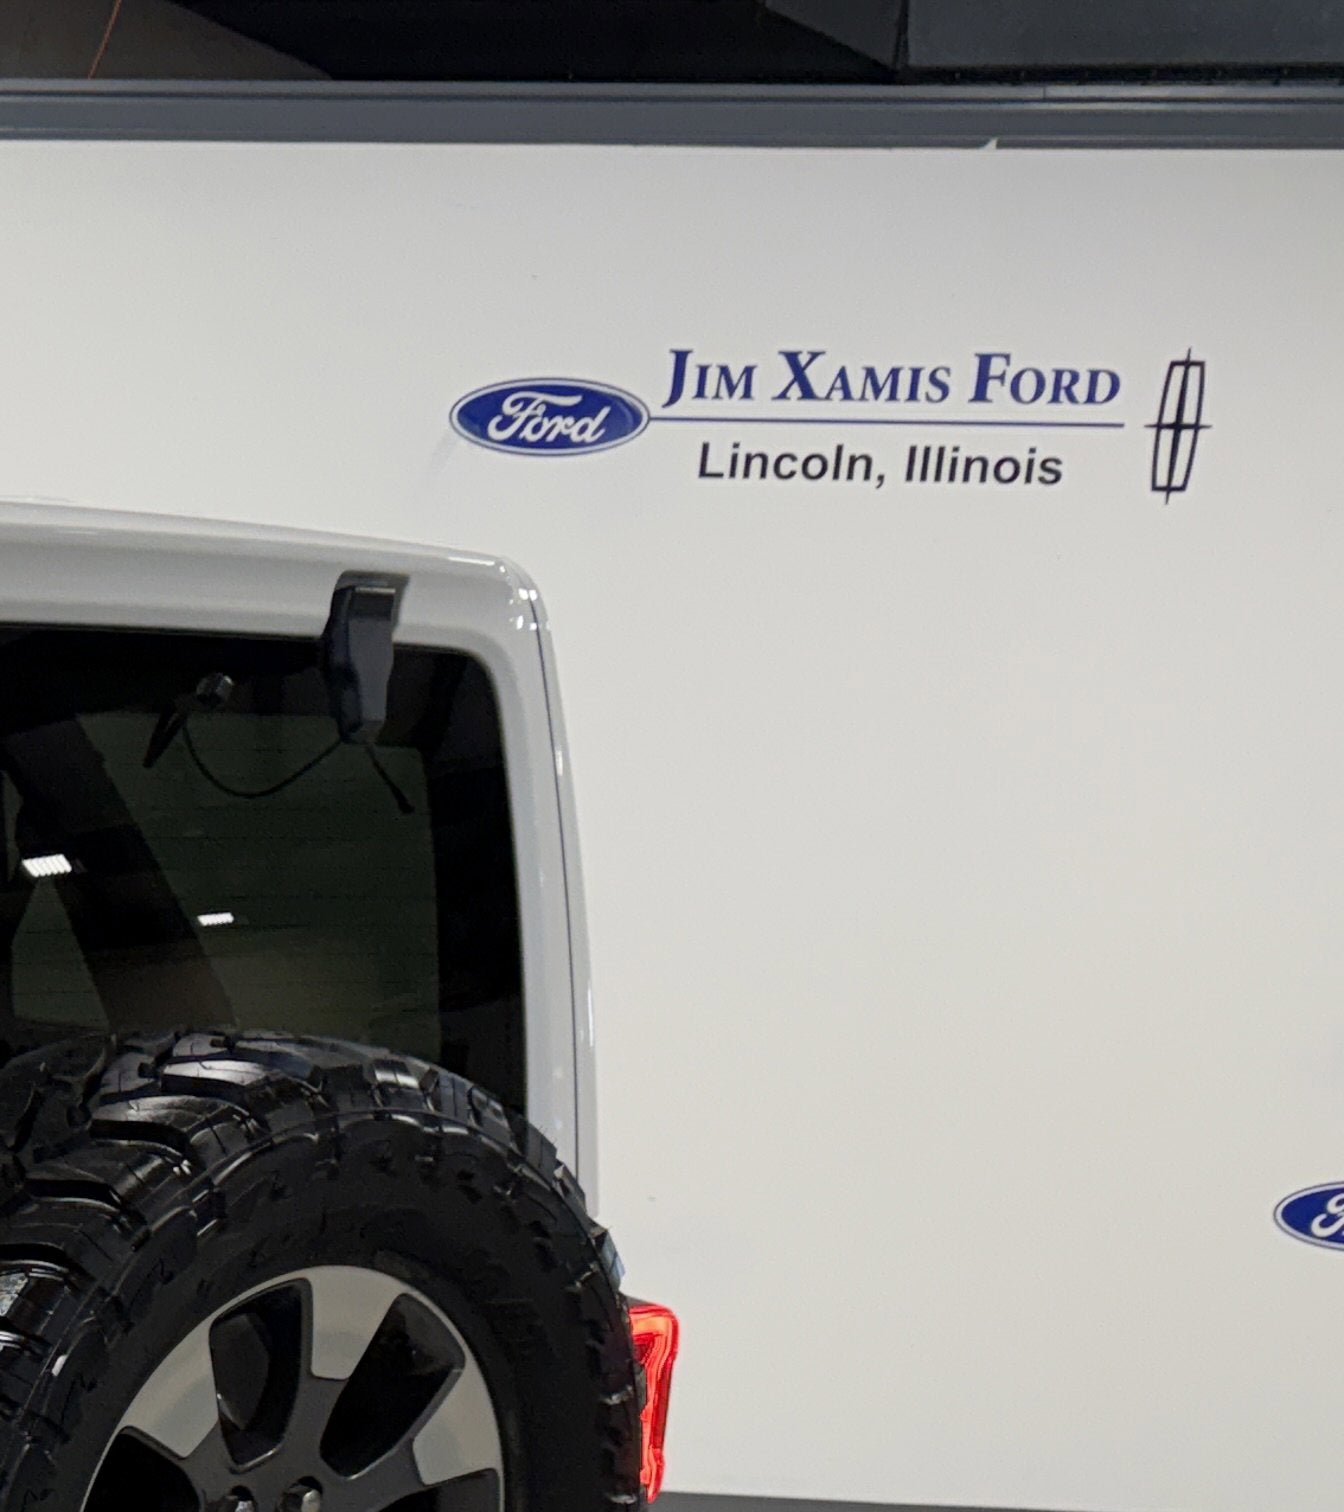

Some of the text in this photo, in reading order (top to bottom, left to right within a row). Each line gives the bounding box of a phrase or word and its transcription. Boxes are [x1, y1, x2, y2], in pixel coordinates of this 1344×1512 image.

[661, 349, 1122, 409] JIM XAMIS FORD
[485, 391, 609, 445] Ford
[698, 442, 1063, 489] Lincoln, Illinois
